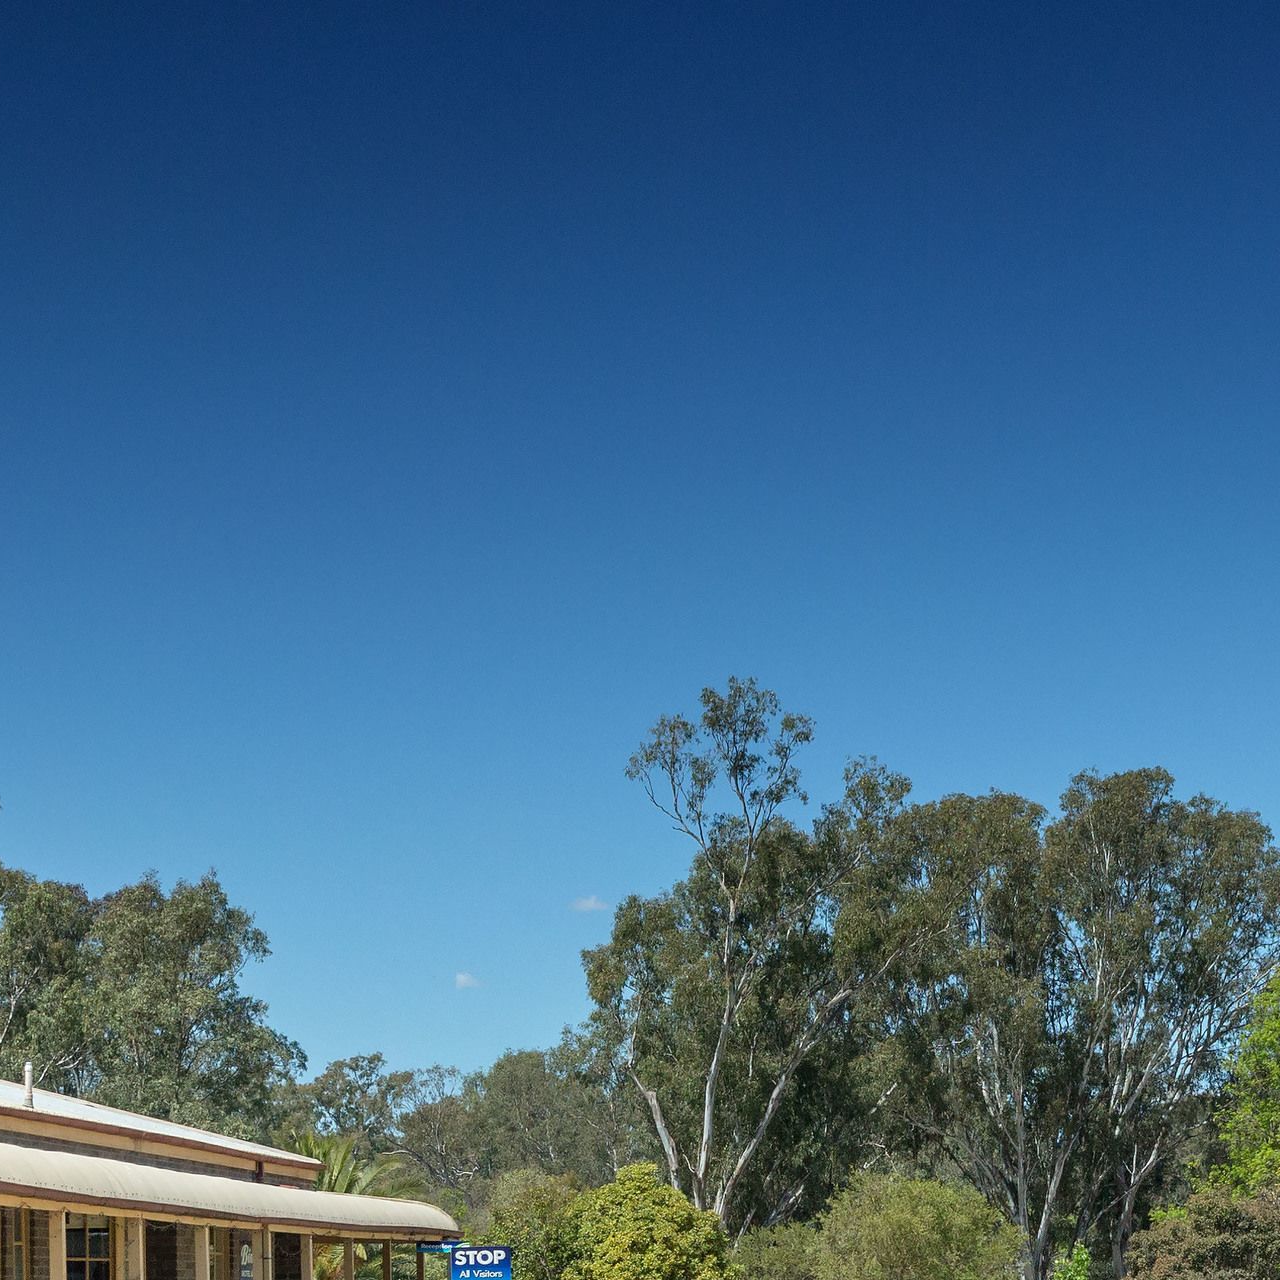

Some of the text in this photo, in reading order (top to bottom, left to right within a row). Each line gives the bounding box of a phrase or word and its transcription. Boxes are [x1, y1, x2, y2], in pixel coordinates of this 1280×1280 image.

[455, 1250, 506, 1265] STOP
[460, 1270, 503, 1278] All Visitors
